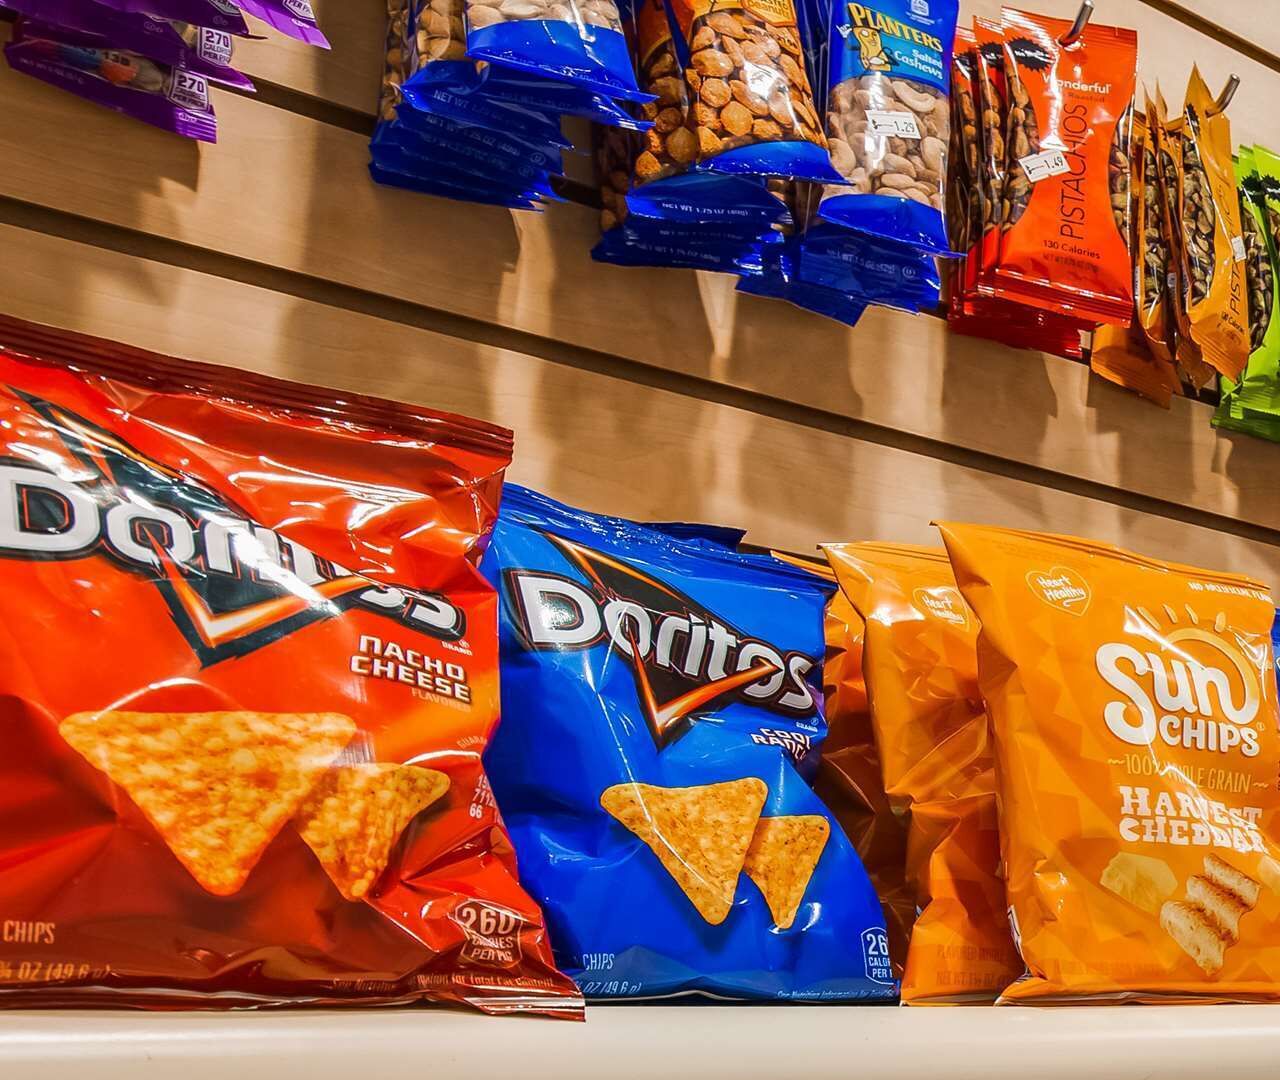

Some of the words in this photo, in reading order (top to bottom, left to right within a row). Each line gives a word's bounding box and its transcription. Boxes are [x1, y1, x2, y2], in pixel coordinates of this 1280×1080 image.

[206, 31, 229, 48] 270
[850, 2, 944, 52] PLANTERS
[894, 51, 943, 80] Cashews
[912, 49, 943, 69] Salted
[178, 76, 204, 92] 270
[1059, 103, 1088, 240] PISTACHIOS
[1044, 240, 1059, 251] 130
[1061, 242, 1101, 260] Calories
[1038, 576, 1073, 595] Heart
[1042, 585, 1089, 606] Healthy
[517, 572, 813, 711] Doritos
[359, 635, 465, 681] NACHO
[351, 655, 472, 702] CHEESE
[1096, 642, 1260, 746] Sun
[1159, 715, 1260, 757] CHIPS
[1207, 770, 1252, 793] GRAIN
[1120, 785, 1263, 832] HARVEST
[1120, 817, 1267, 853] CHEDDAR
[3, 919, 56, 944] CHIPS
[461, 905, 513, 934] 260
[471, 948, 494, 962] PER
[583, 953, 614, 973] CHIPS
[873, 968, 887, 979] PER
